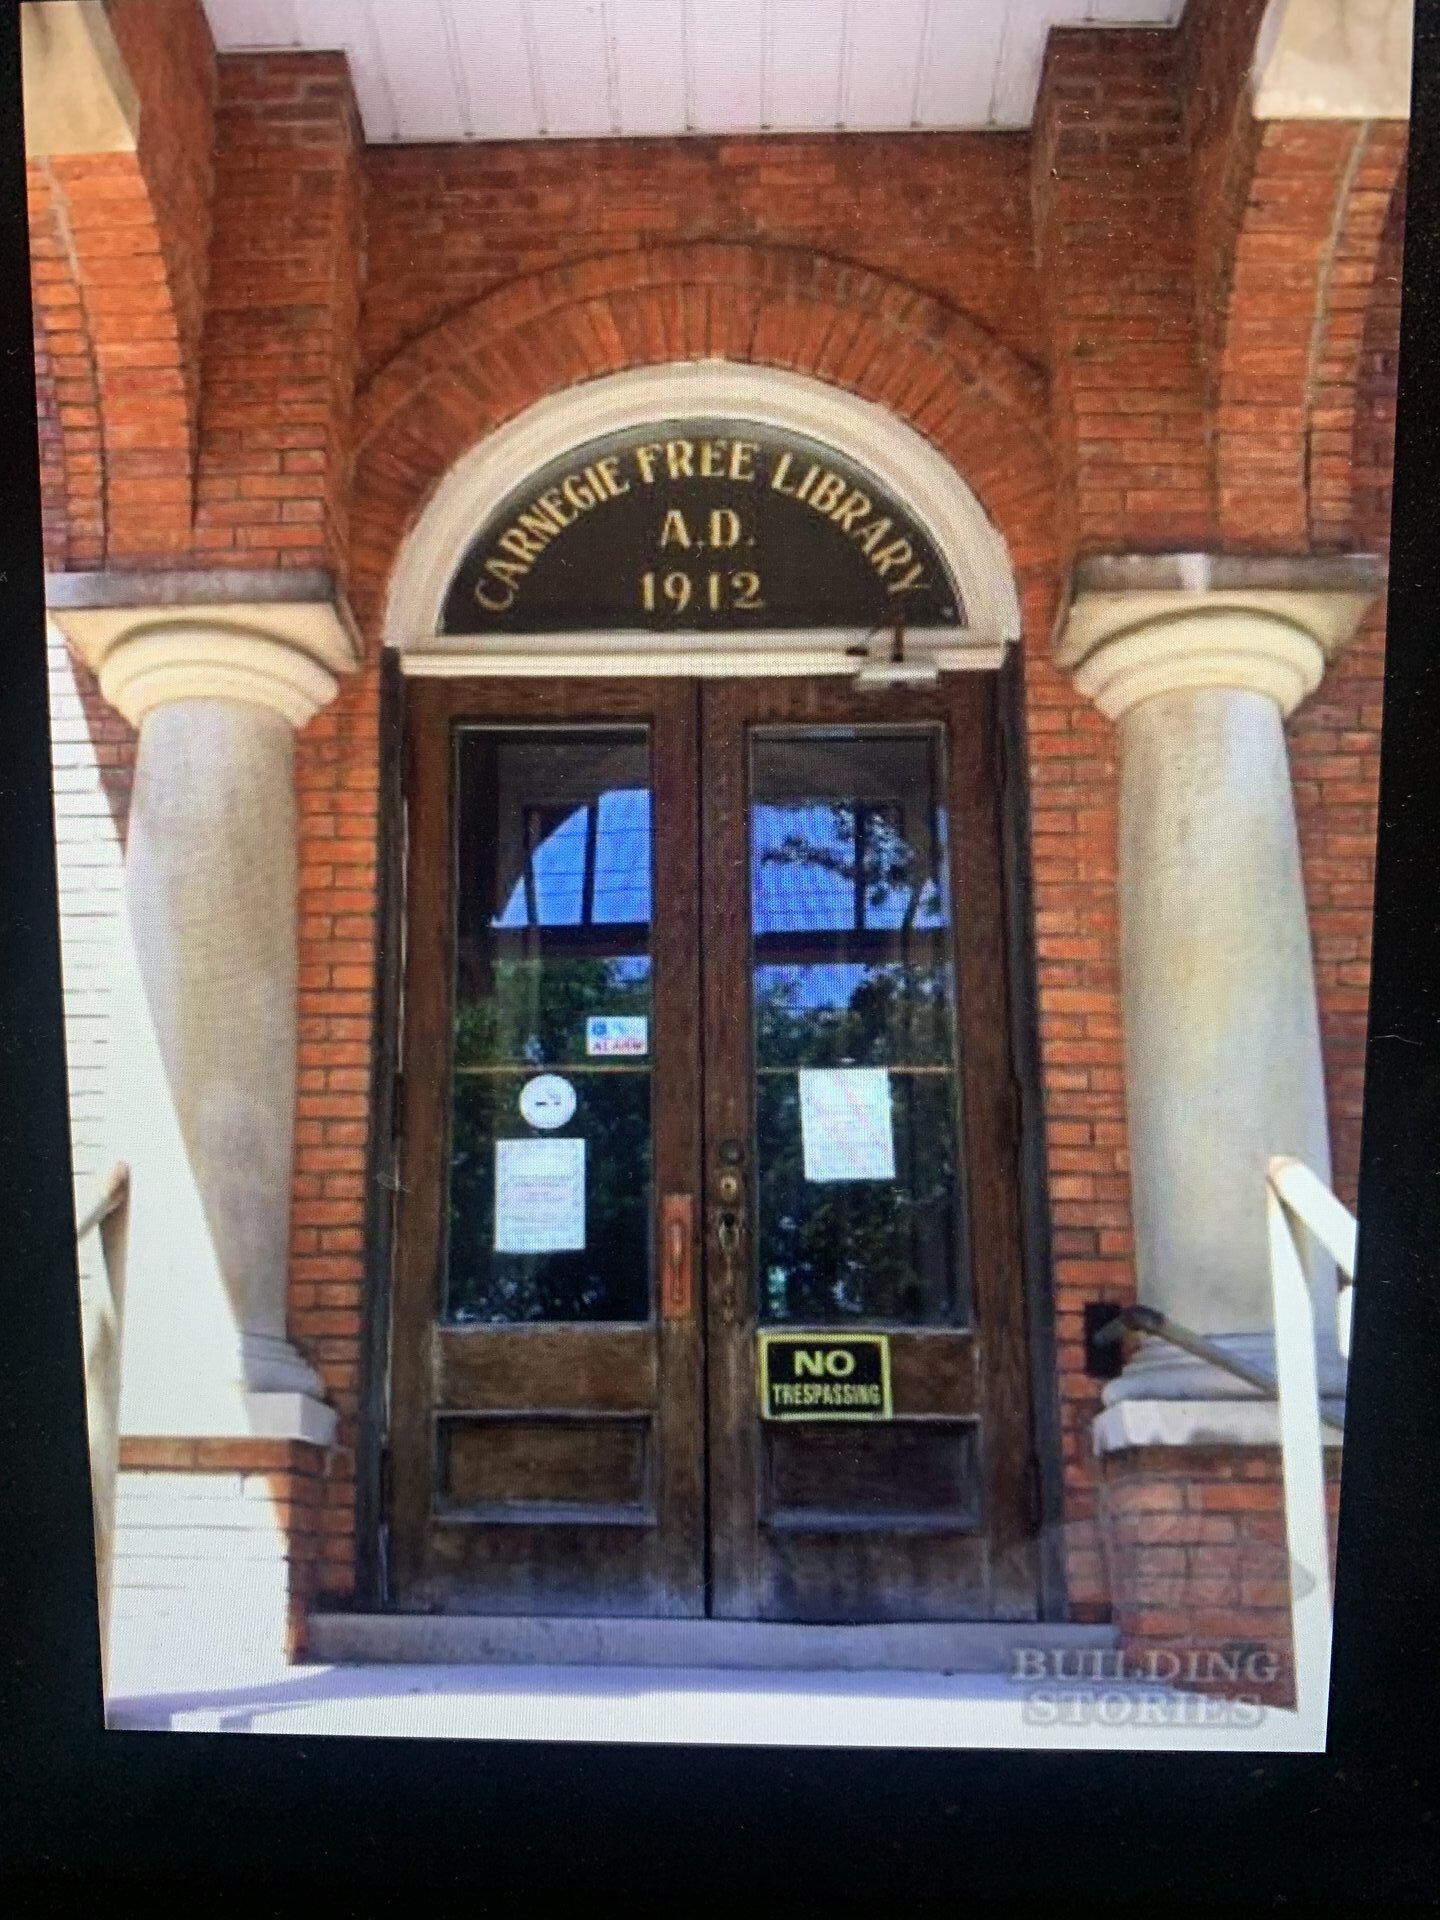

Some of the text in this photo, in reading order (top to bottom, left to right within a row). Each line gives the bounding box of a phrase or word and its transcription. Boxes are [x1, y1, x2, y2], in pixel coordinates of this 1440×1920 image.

[474, 439, 931, 611] CARNEGIE FREE LIBRARY
[660, 508, 756, 549] A.D.
[641, 570, 765, 614] 1912
[794, 1350, 856, 1377] NO
[772, 1383, 882, 1406] TRESPASSING
